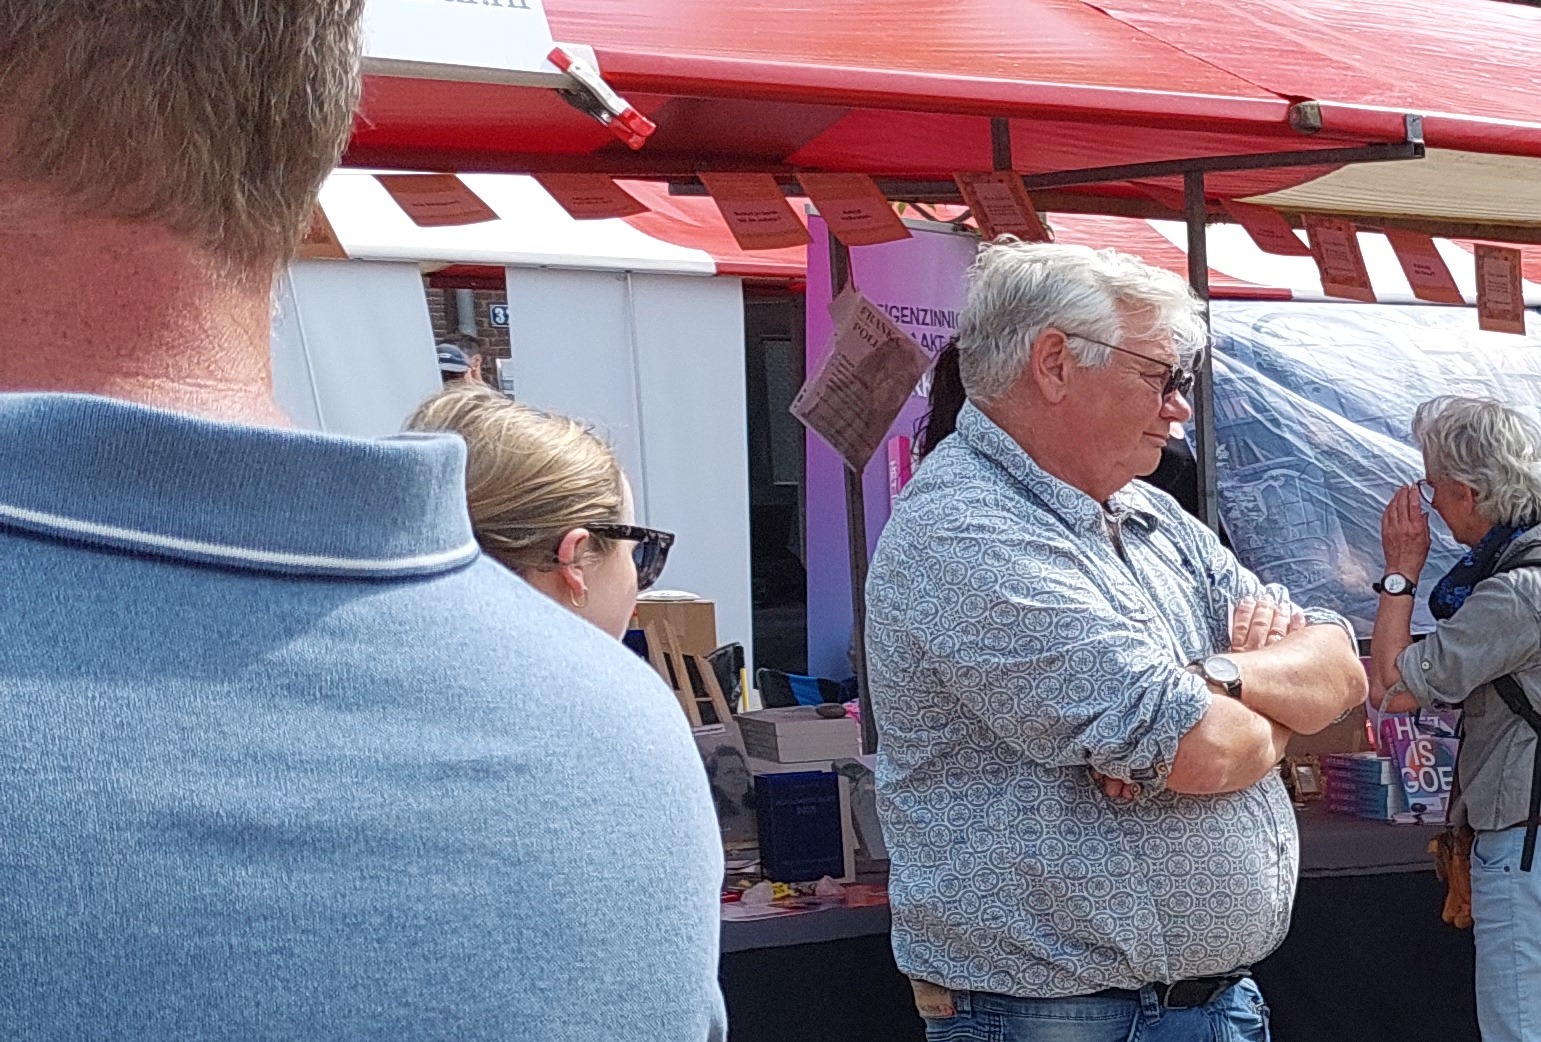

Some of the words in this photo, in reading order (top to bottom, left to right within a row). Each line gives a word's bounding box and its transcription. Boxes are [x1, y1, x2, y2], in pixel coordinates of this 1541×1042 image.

[494, 307, 510, 325] 3
[1409, 740, 1436, 767] IS
[1400, 766, 1454, 794] GOE
